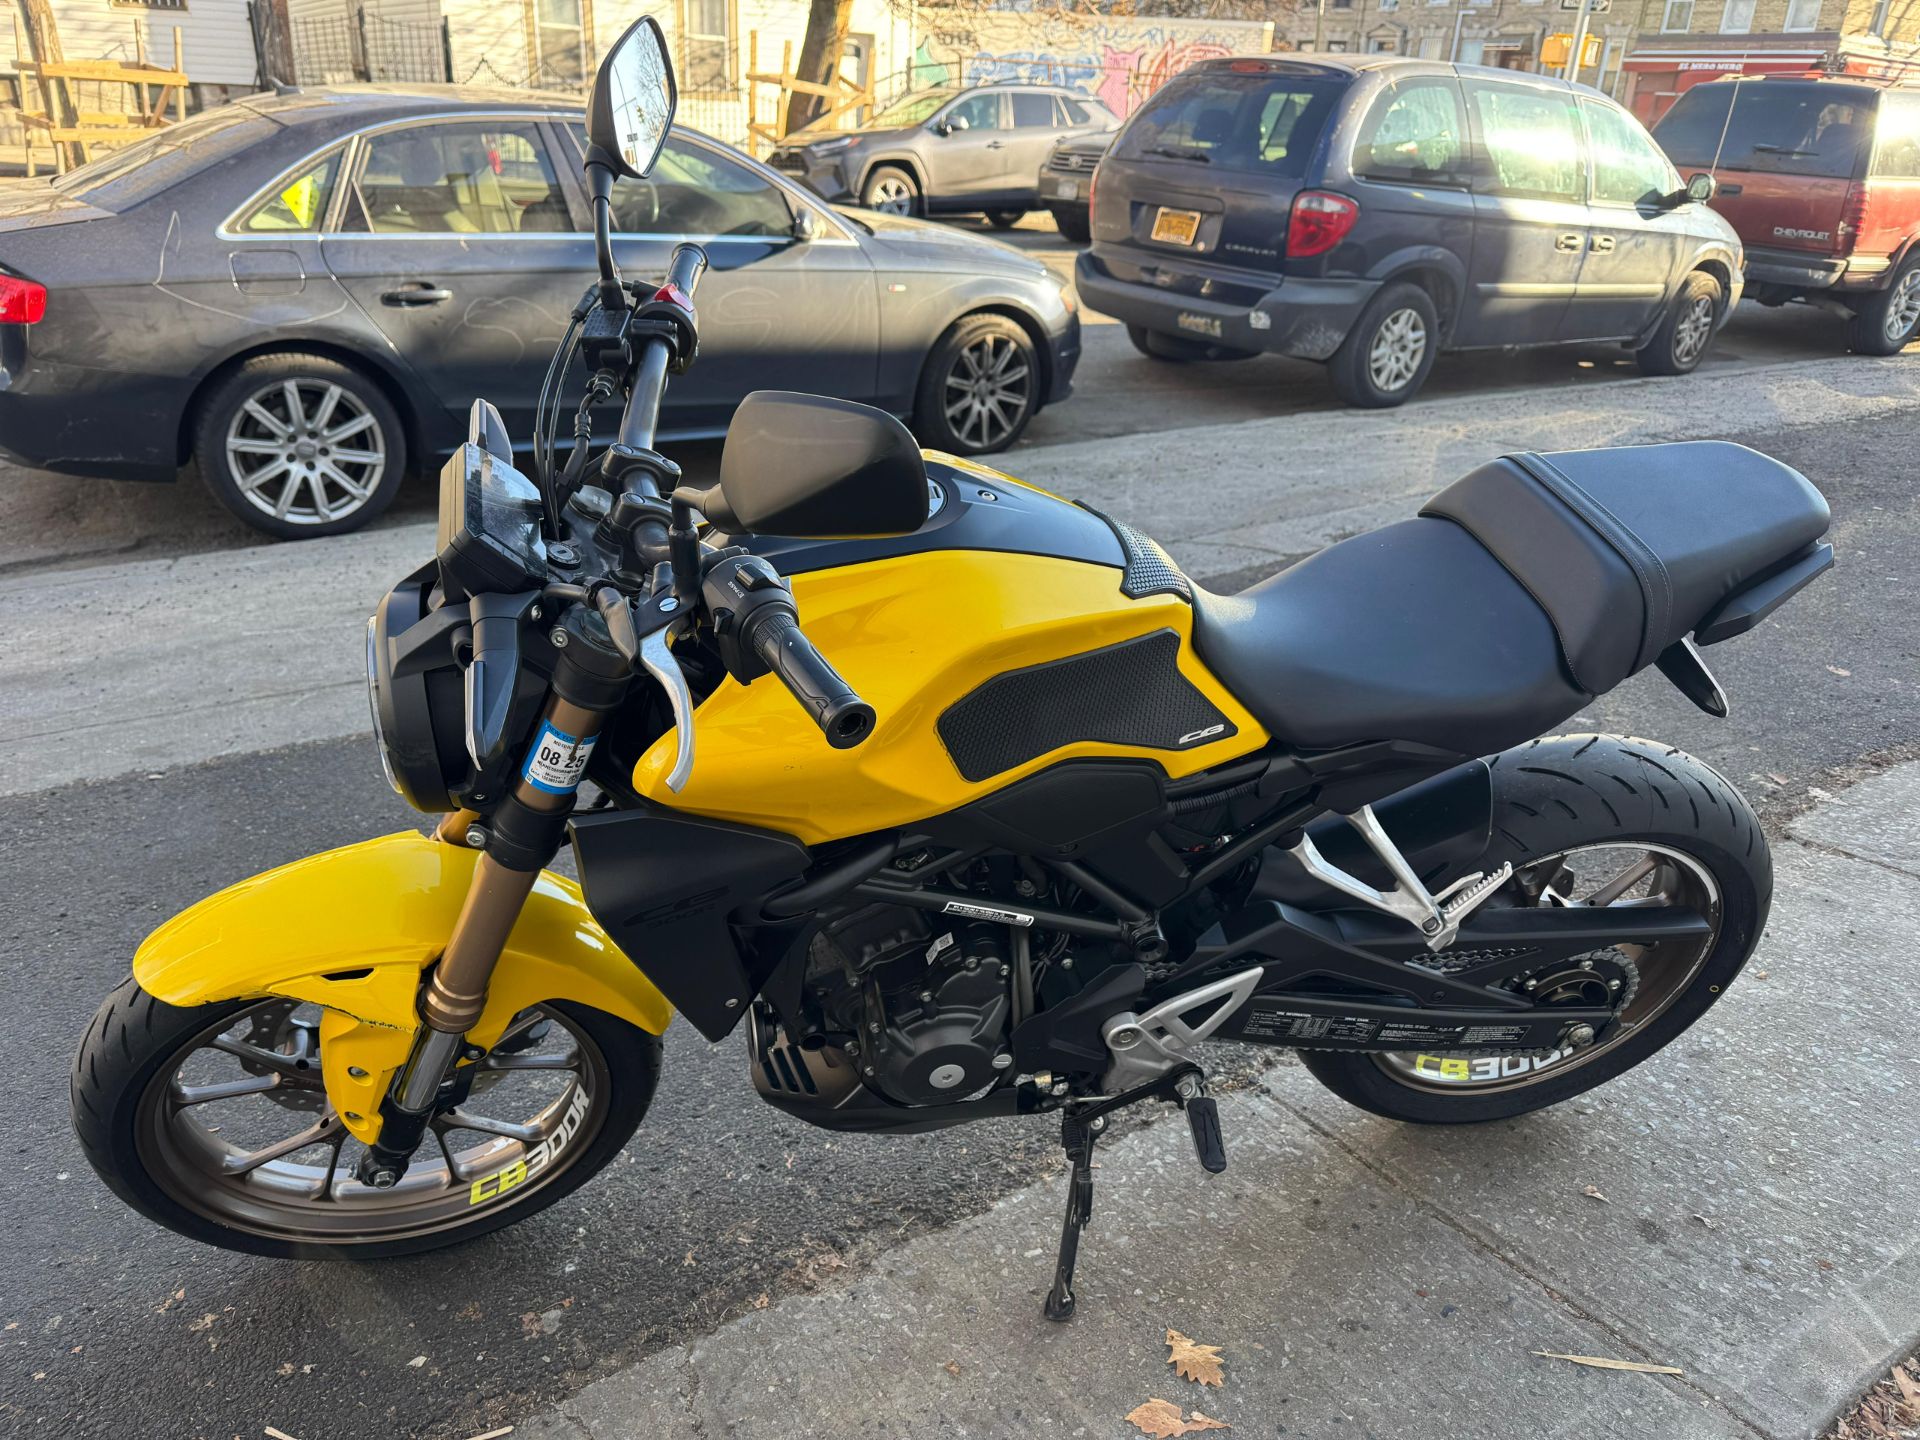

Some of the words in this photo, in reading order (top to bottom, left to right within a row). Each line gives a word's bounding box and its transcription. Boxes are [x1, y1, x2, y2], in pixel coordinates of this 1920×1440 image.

[1773, 227, 1830, 240] CHEVROLET
[540, 746, 561, 766] 08
[564, 754, 586, 768] 25
[1416, 1047, 1573, 1080] CB300
[470, 1083, 590, 1205] CB300R
